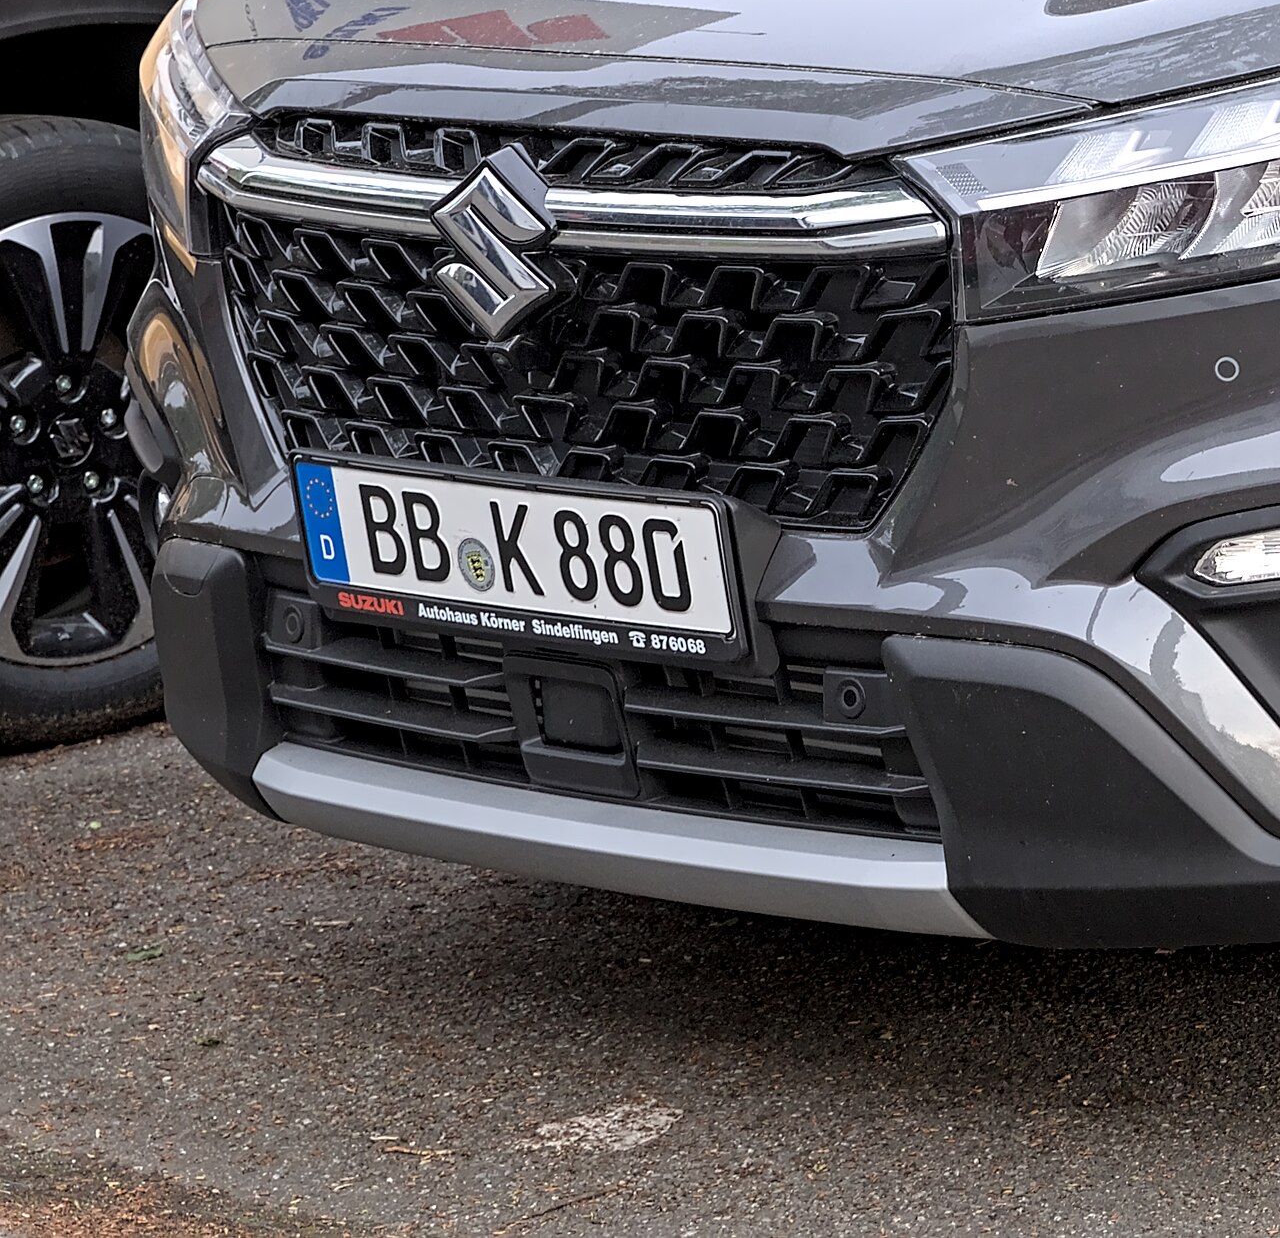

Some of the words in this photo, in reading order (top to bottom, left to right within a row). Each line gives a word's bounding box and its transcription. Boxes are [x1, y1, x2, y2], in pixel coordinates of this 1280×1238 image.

[320, 534, 335, 560] D
[358, 483, 450, 582] BB
[489, 500, 546, 596] K
[553, 509, 693, 613] 880
[337, 591, 404, 616] SUZUKI
[417, 602, 478, 626] Autohaus
[480, 611, 525, 633] Körner
[531, 618, 619, 645] Sindelfingen
[650, 634, 707, 654] 876068
